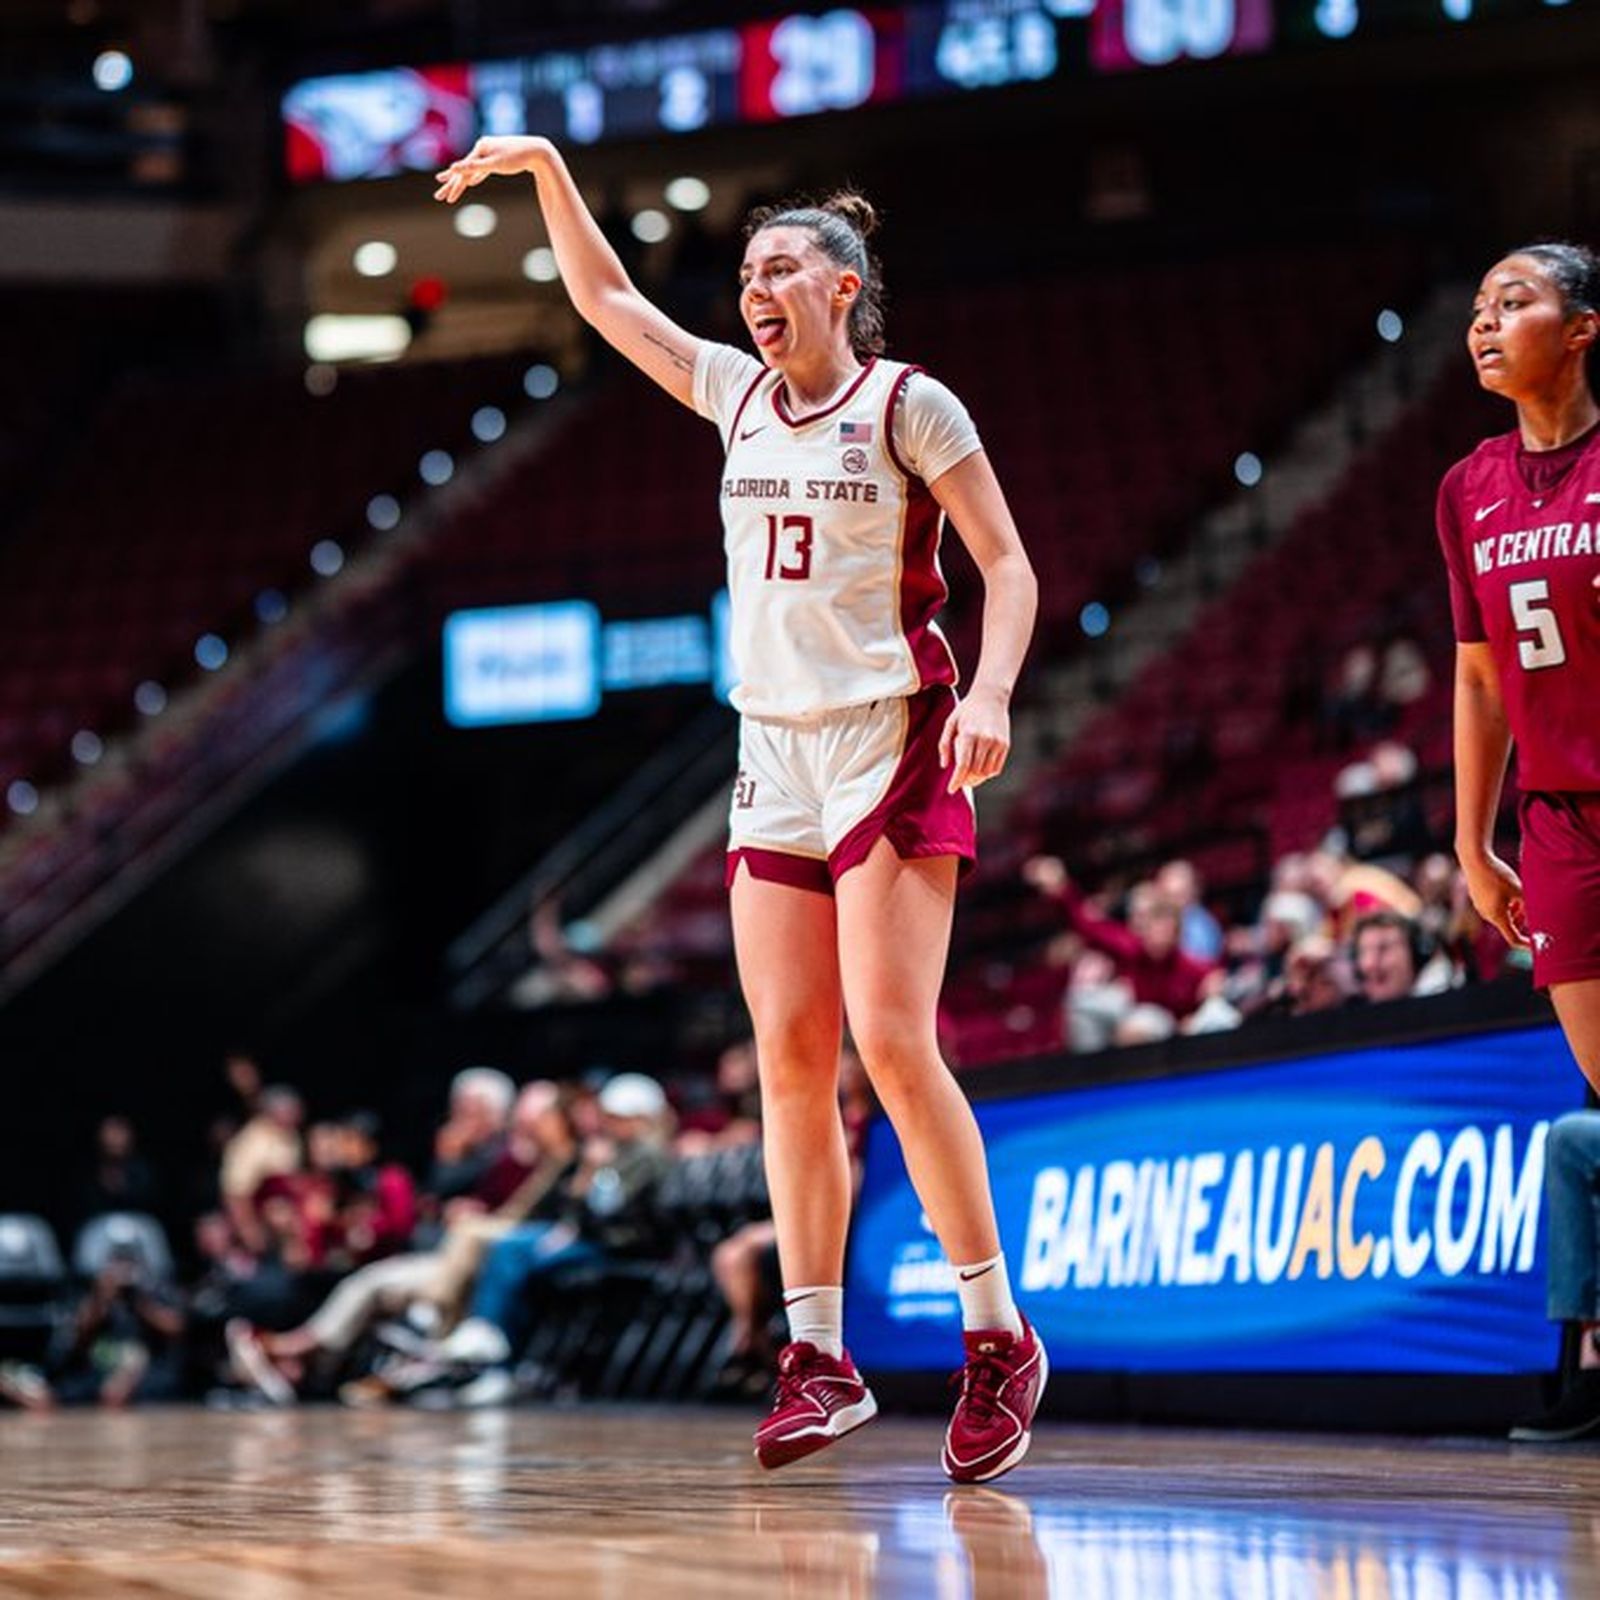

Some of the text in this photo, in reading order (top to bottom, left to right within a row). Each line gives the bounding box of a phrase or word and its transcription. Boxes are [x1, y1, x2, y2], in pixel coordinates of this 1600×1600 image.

[805, 480, 879, 503] STATE
[764, 514, 813, 580] 13
[1473, 521, 1600, 576] NC CENTRA
[1508, 578, 1566, 671] 5
[1020, 1120, 1551, 1292] BARINEAUAC.COM
